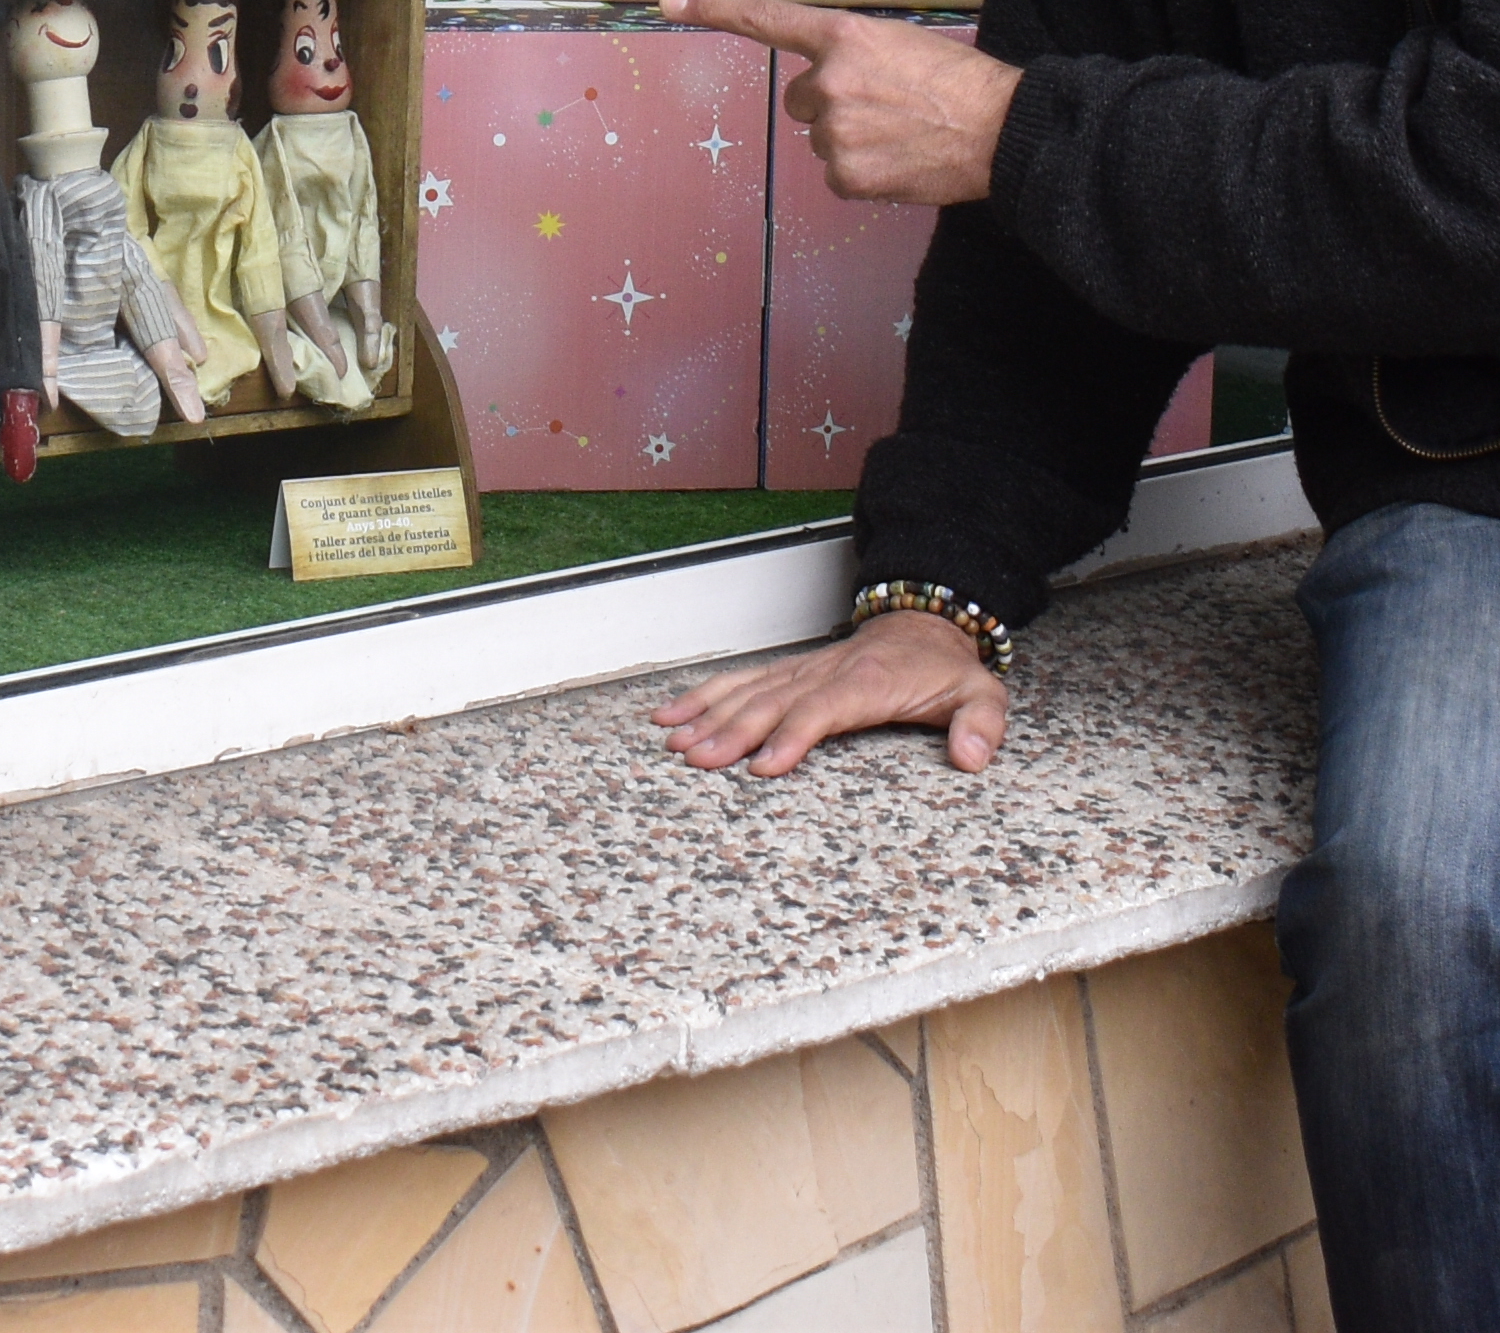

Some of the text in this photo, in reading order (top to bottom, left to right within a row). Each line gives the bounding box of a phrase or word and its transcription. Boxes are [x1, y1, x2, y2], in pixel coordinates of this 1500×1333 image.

[300, 487, 453, 511] Conjunt d'antigues titelles
[322, 503, 435, 523] de guant Catalanes.
[346, 518, 375, 534] Anys
[312, 527, 450, 549] Taller artesà de fusteria
[316, 547, 356, 562] titelles
[358, 545, 376, 558] del
[379, 543, 404, 557] Baix
[406, 538, 457, 555] empordà
